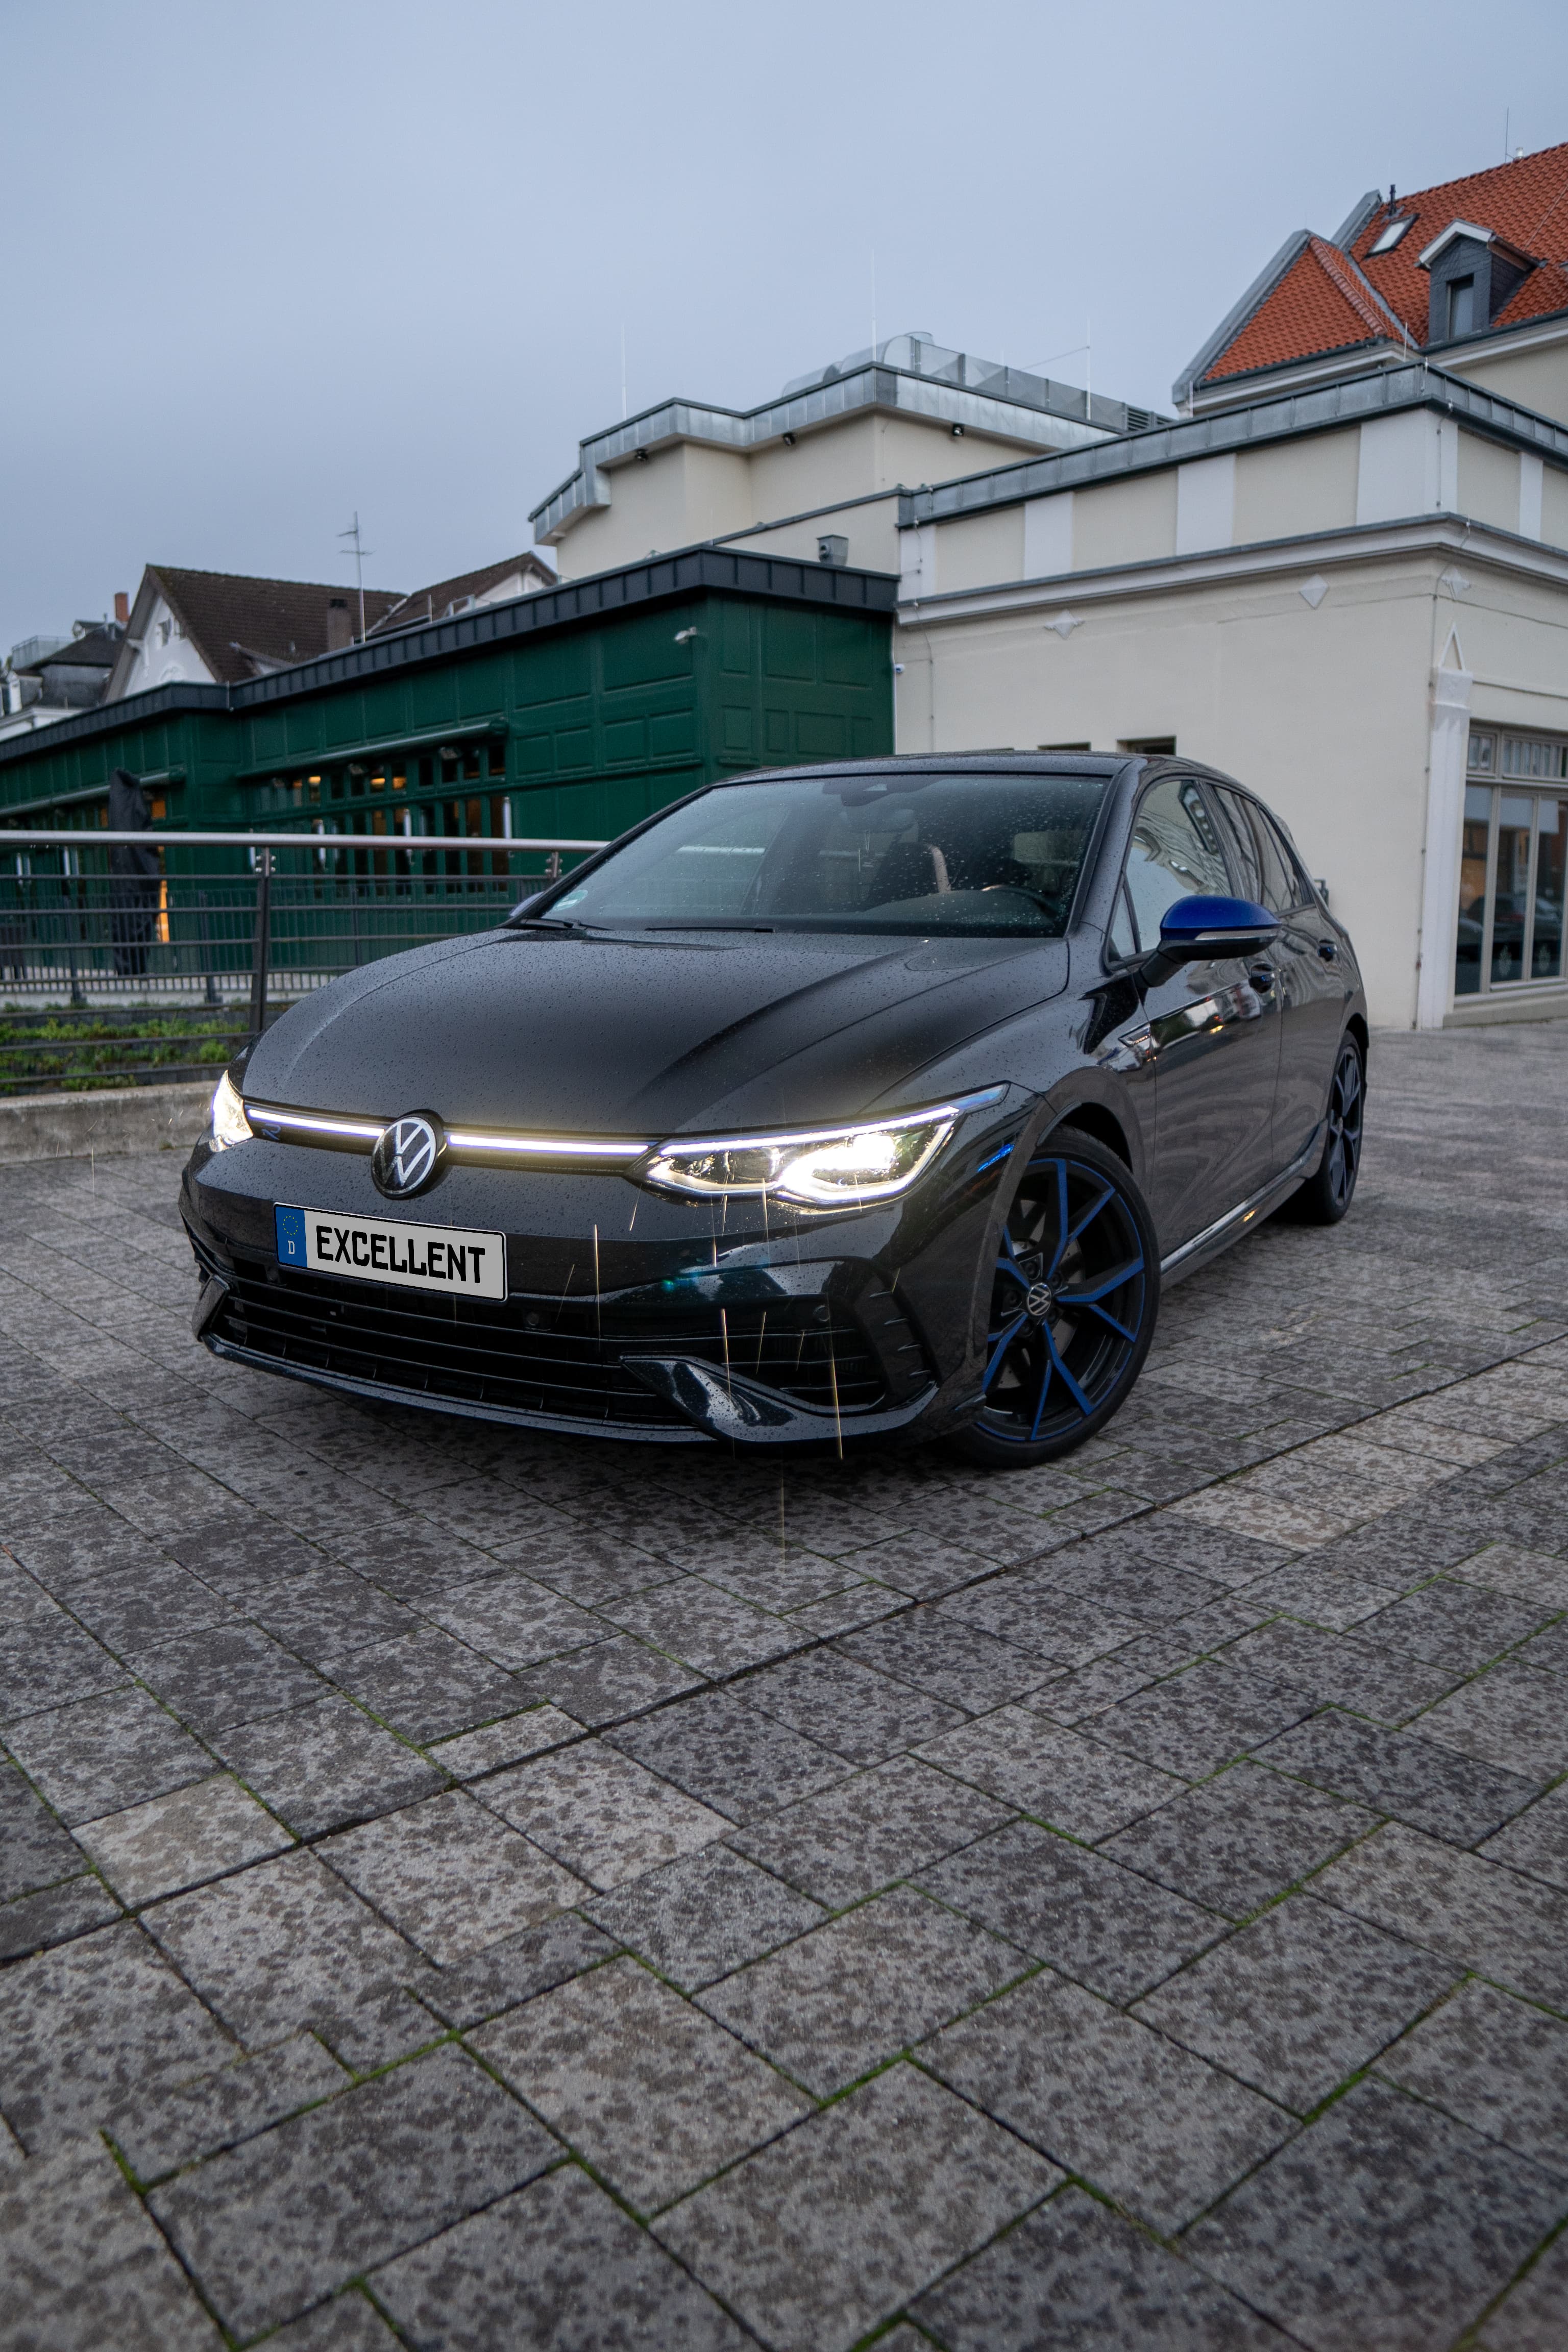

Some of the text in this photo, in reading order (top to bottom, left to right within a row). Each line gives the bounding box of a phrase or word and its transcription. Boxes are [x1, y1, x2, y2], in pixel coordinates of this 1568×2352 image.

[373, 1117, 436, 1194] VW
[287, 1240, 295, 1255] D
[316, 1225, 485, 1284] EXCELLENT
